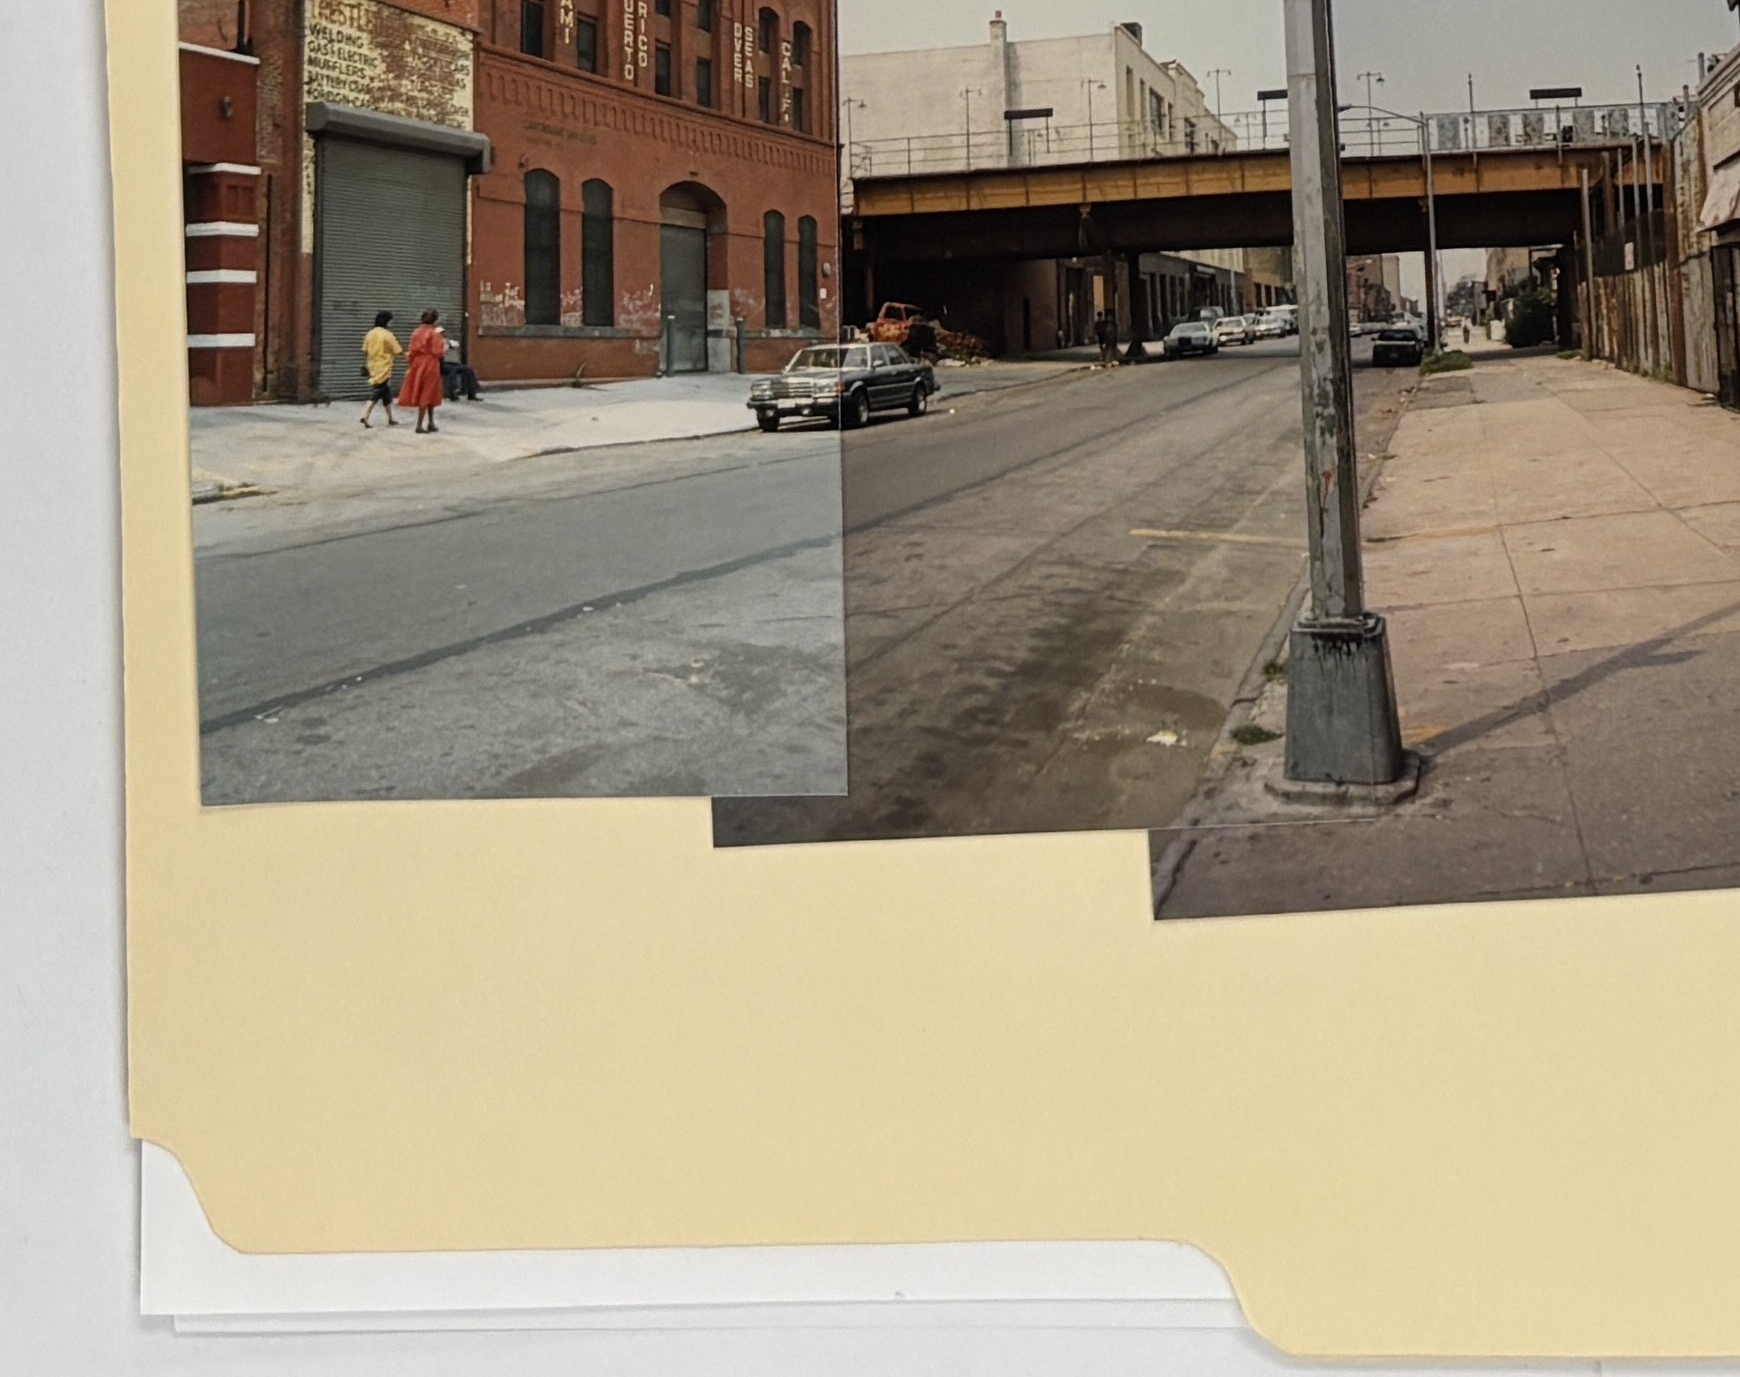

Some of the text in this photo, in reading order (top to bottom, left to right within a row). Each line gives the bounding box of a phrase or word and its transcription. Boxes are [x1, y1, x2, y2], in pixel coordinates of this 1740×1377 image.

[638, 1, 648, 68] RICO
[733, 21, 743, 83] OVER
[744, 25, 754, 89] SEAS
